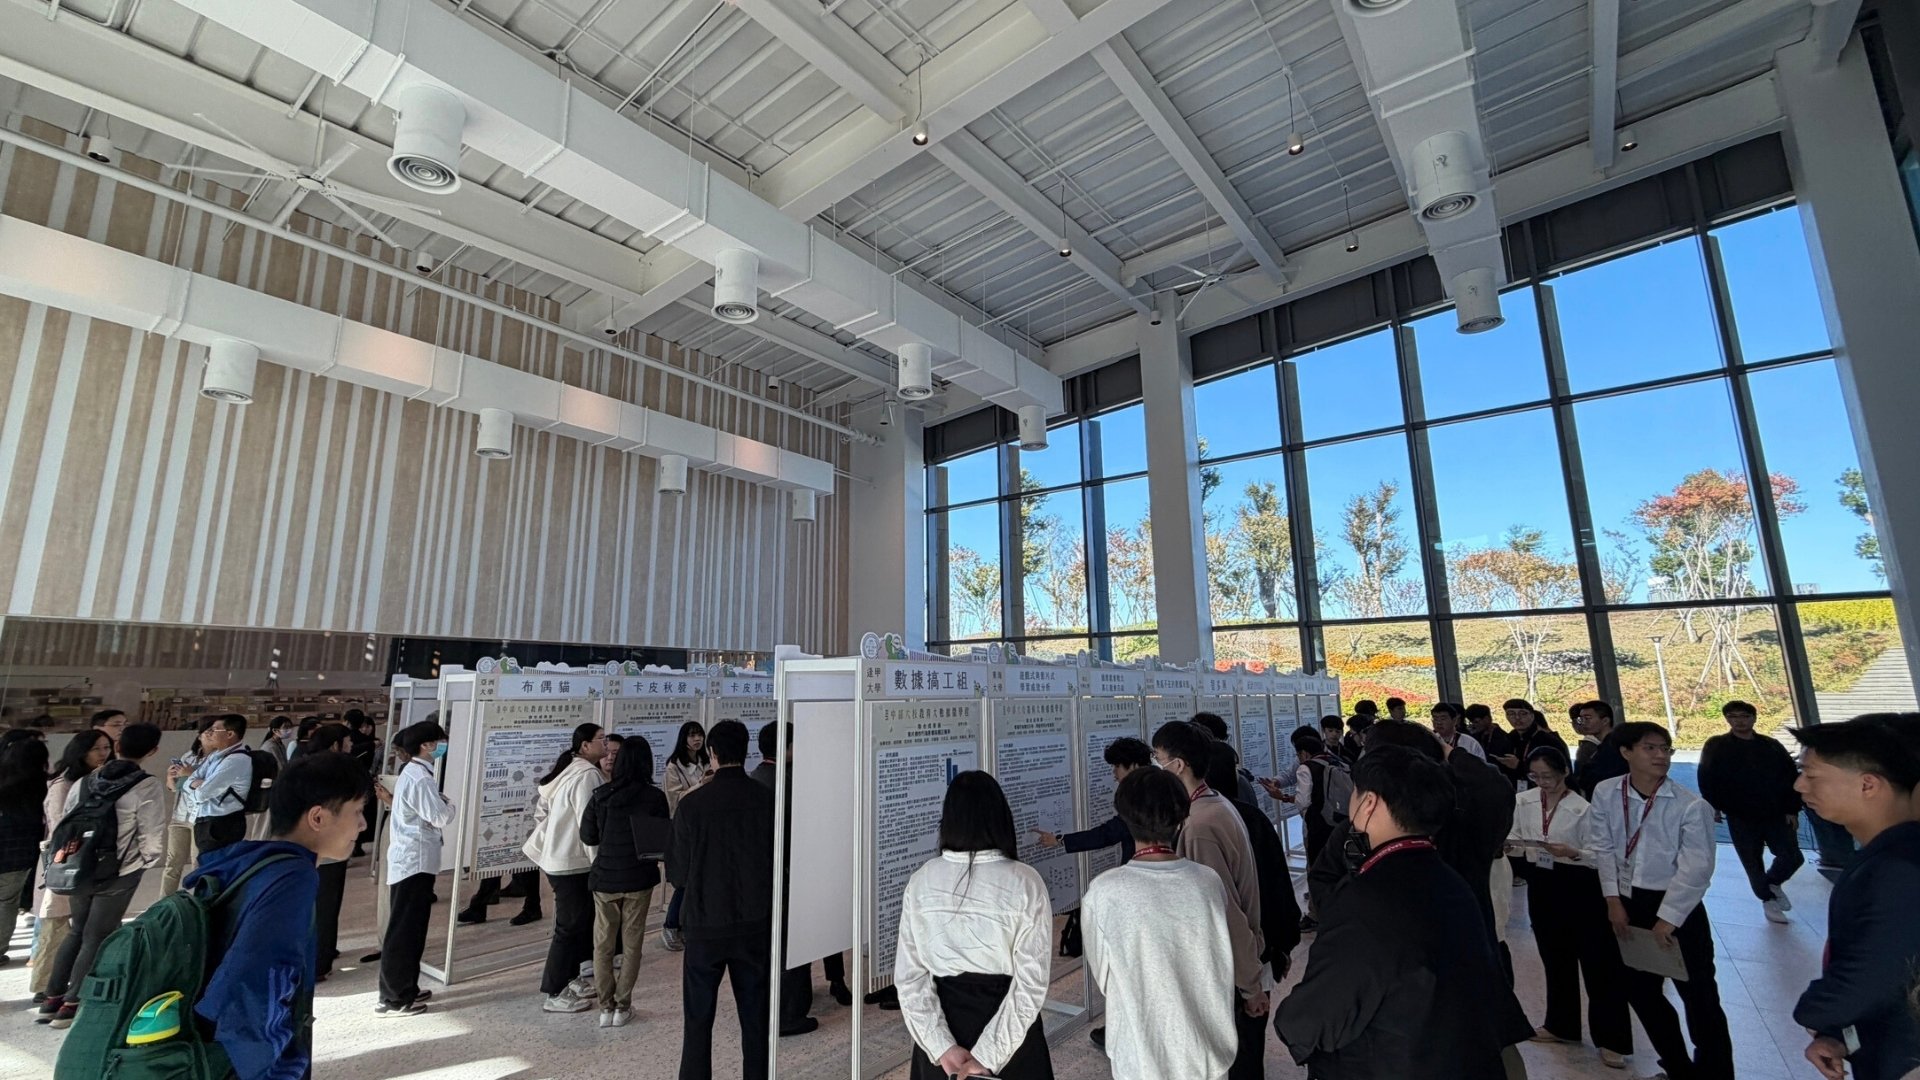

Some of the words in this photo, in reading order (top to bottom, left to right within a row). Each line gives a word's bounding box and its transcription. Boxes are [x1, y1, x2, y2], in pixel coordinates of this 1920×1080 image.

[867, 668, 881, 678] 逢甲
[895, 669, 968, 690] 數據搞工組
[522, 681, 570, 693] 布偶貓
[634, 681, 687, 694] 卡皮秋發
[867, 683, 881, 694] 大學
